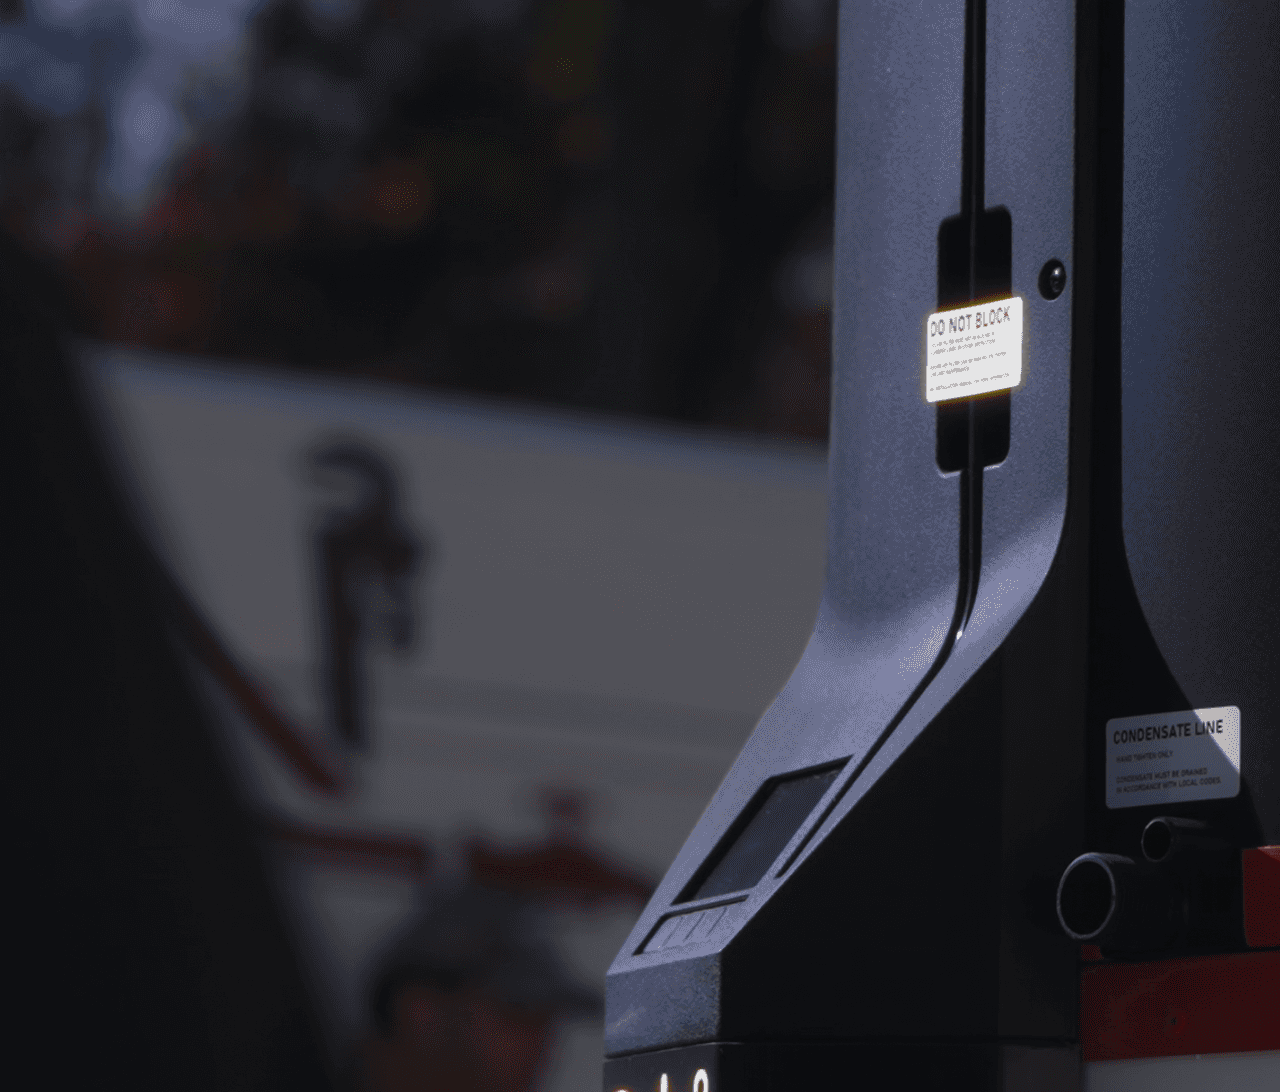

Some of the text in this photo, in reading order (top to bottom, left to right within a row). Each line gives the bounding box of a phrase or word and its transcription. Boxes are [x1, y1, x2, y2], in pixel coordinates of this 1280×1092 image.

[931, 306, 1010, 337] DO NOT BLOCK
[1113, 719, 1223, 744] CONDENSATE LINE
